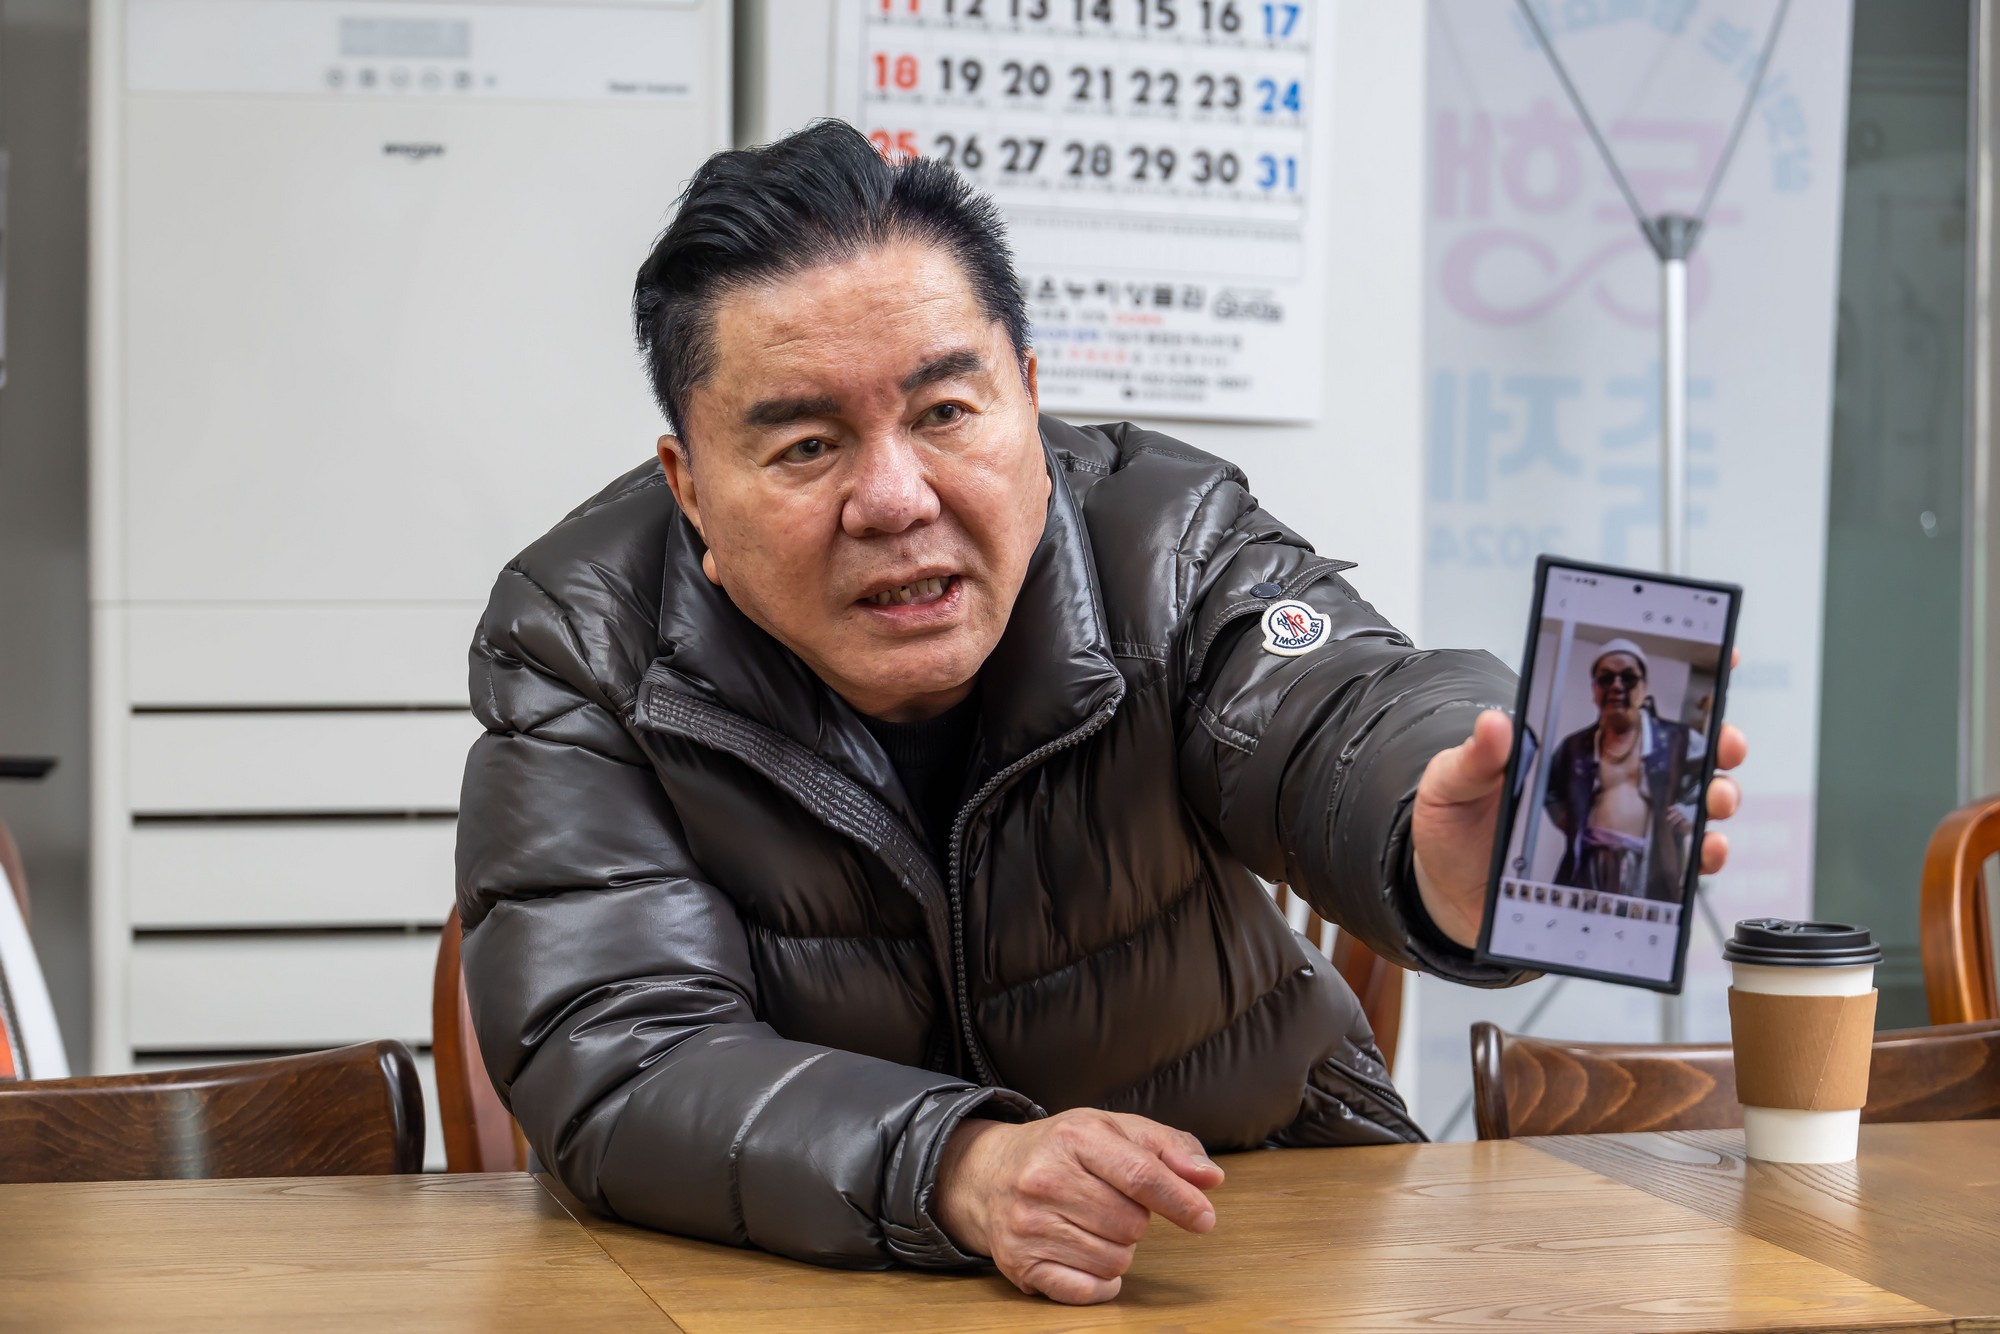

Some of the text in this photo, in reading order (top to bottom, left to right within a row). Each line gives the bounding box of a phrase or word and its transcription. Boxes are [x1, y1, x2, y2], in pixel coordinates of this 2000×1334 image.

[1010, 0, 1049, 20] 13
[1075, 0, 1112, 23] 14
[1140, 0, 1177, 29] 15
[1200, 0, 1242, 33] 16
[1262, 3, 1301, 37] 17
[873, 53, 1301, 114] 18 19 20 21 22 23 24
[869, 130, 1296, 190] 25 26 27 28 29 30 31
[1279, 621, 1320, 646] MONCLER
